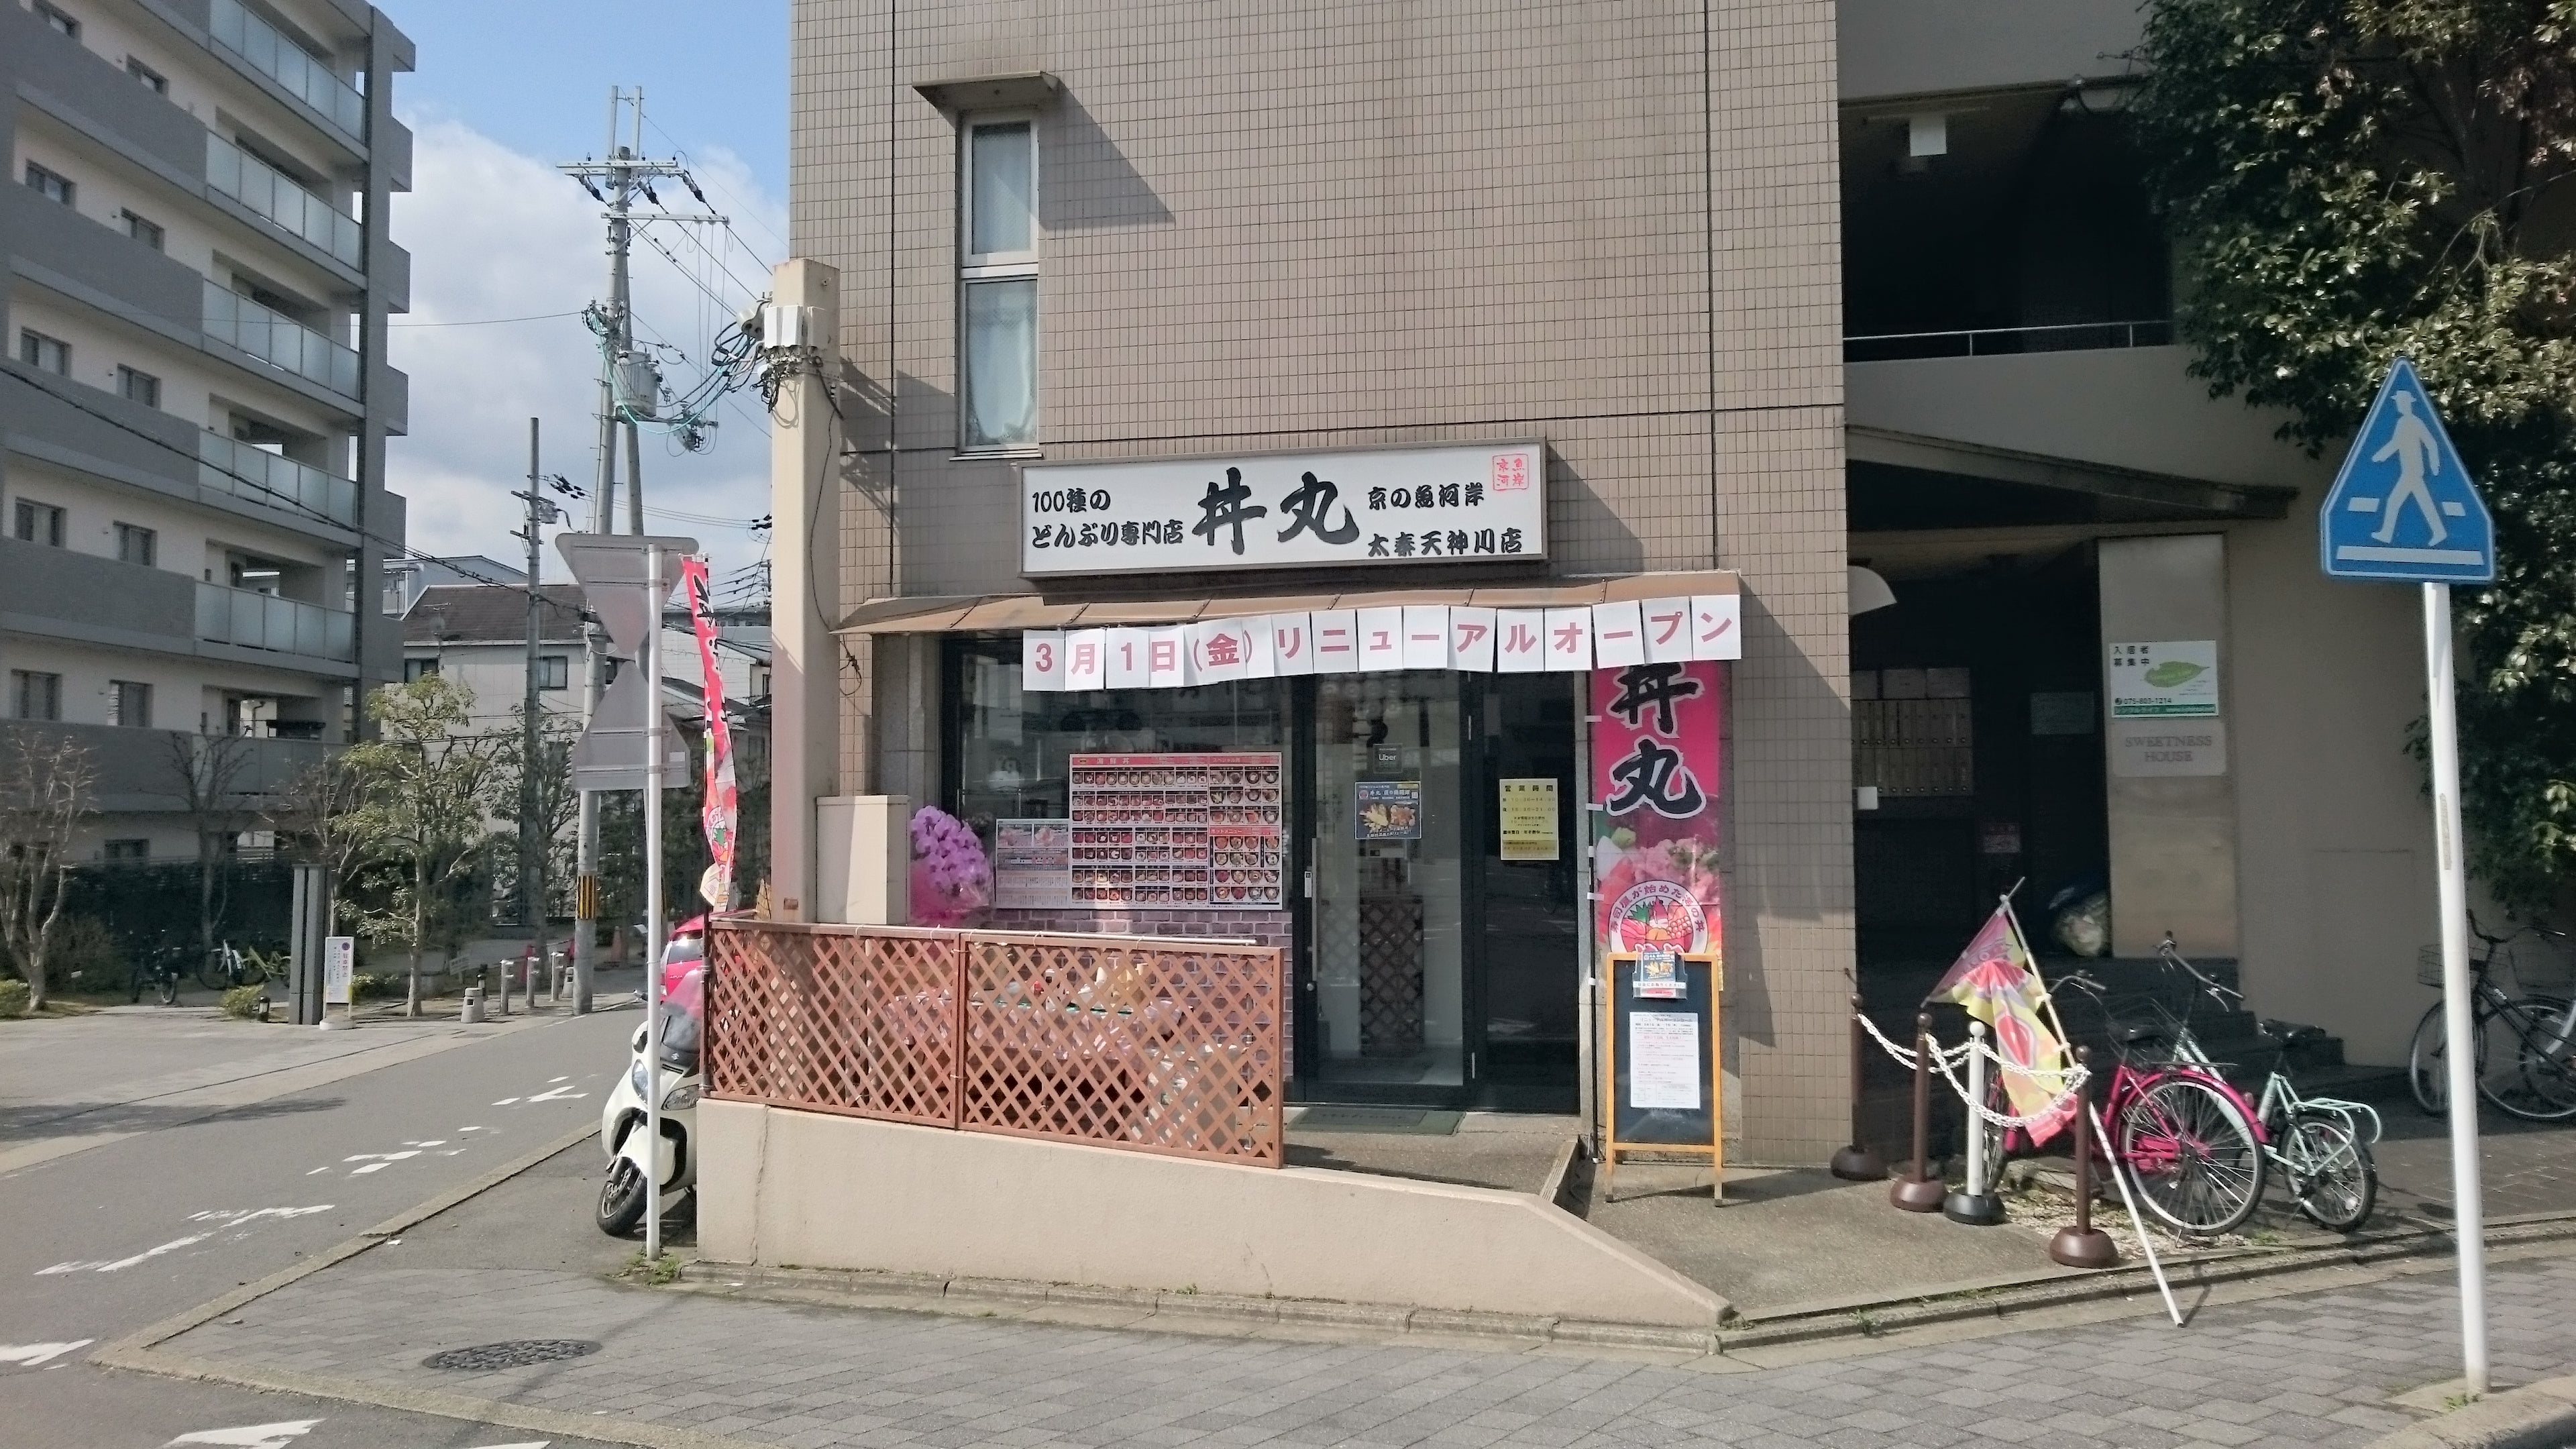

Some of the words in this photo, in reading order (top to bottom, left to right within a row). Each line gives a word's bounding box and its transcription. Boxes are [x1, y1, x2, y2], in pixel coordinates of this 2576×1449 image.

[1032, 488, 1111, 513] 100種の
[1191, 467, 1360, 555] 丼丸
[1368, 482, 1485, 511] 京の魚河岸
[1032, 519, 1183, 548] どんぶり専門店
[1368, 527, 1522, 557] 太秦天神川店
[1607, 663, 1706, 817] 丼丸
[2125, 735, 2212, 747] SWEETNESS
[2145, 751, 2193, 762] HOUSE
